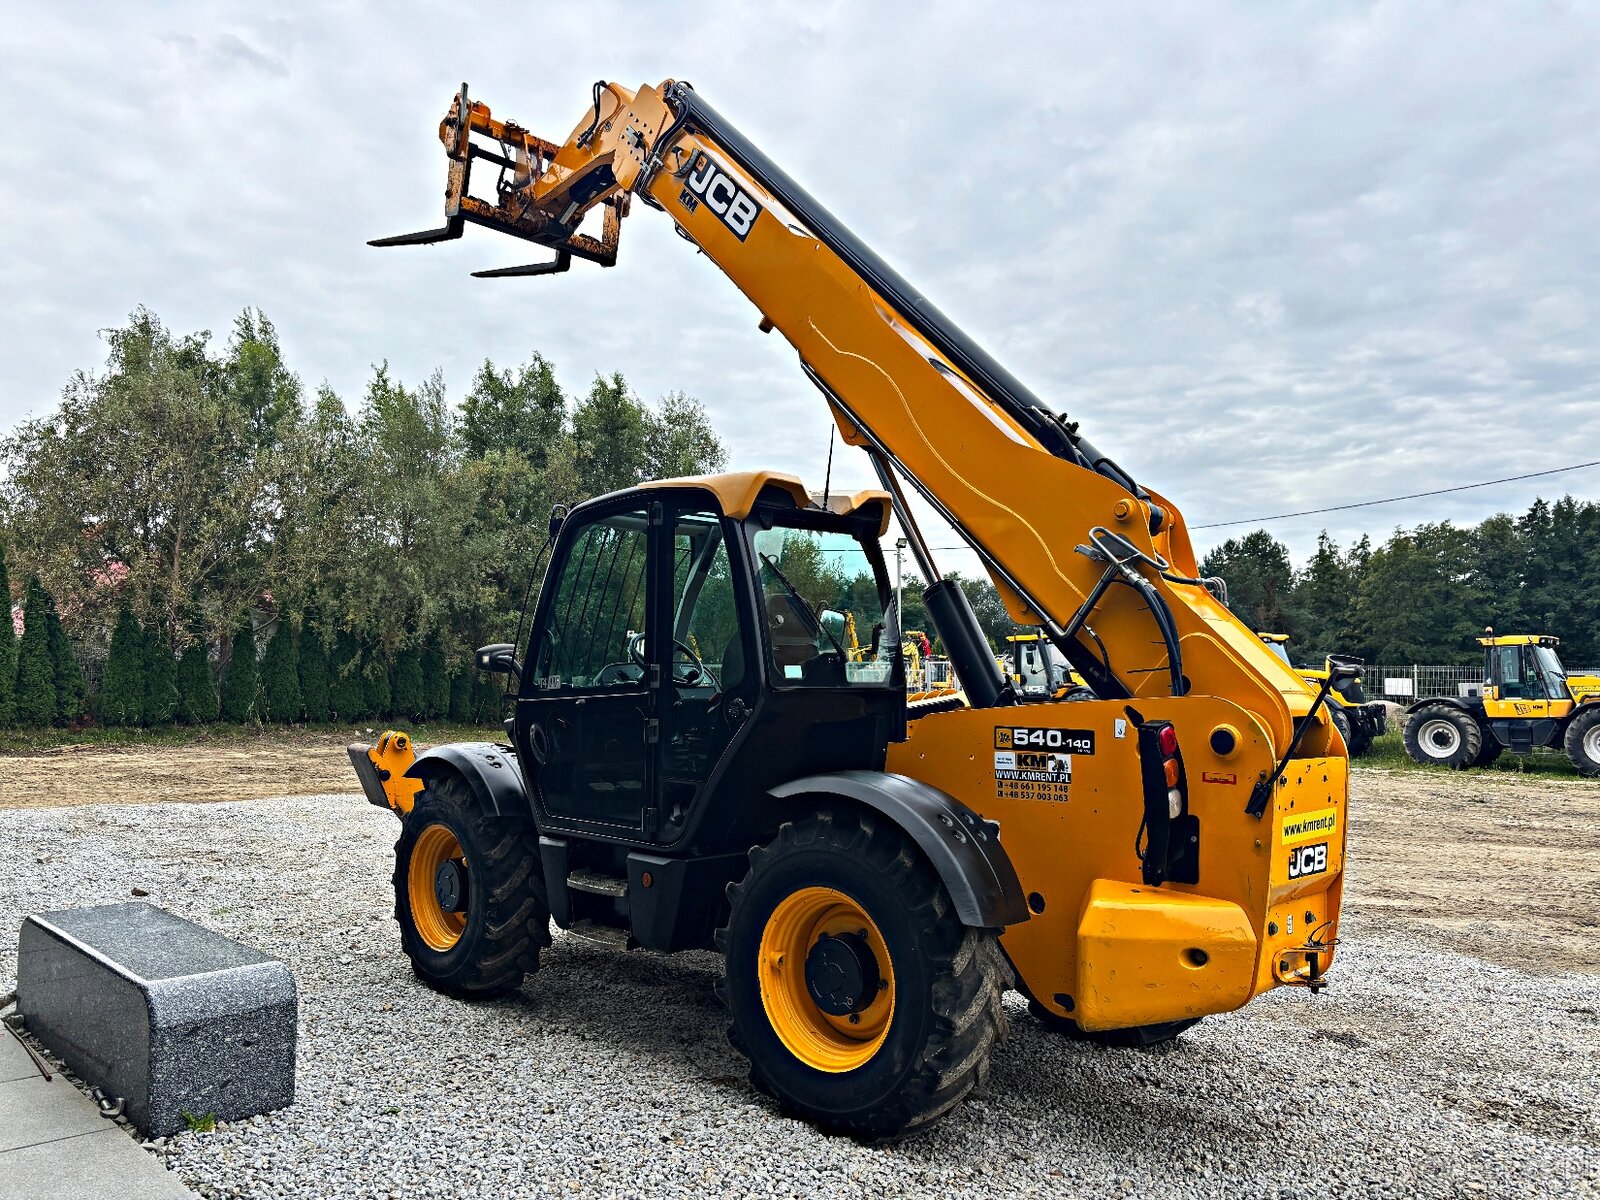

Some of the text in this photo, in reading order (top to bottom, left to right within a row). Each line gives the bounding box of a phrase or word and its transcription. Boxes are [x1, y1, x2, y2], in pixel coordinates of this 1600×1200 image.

[679, 189, 699, 213] KM
[688, 164, 757, 236] JCB
[1025, 685, 1045, 693] JCB
[1013, 729, 1090, 748] 540-140
[1017, 754, 1047, 767] KM
[995, 770, 1070, 782] WWW.KMRENT.PL
[1004, 782, 1069, 793] +48 661 195 148
[1021, 791, 1035, 800] 537
[1037, 792, 1052, 801] 003
[1054, 793, 1069, 802] 063
[1283, 813, 1335, 837] www.kmrent.pl
[1290, 846, 1326, 876] JCB
